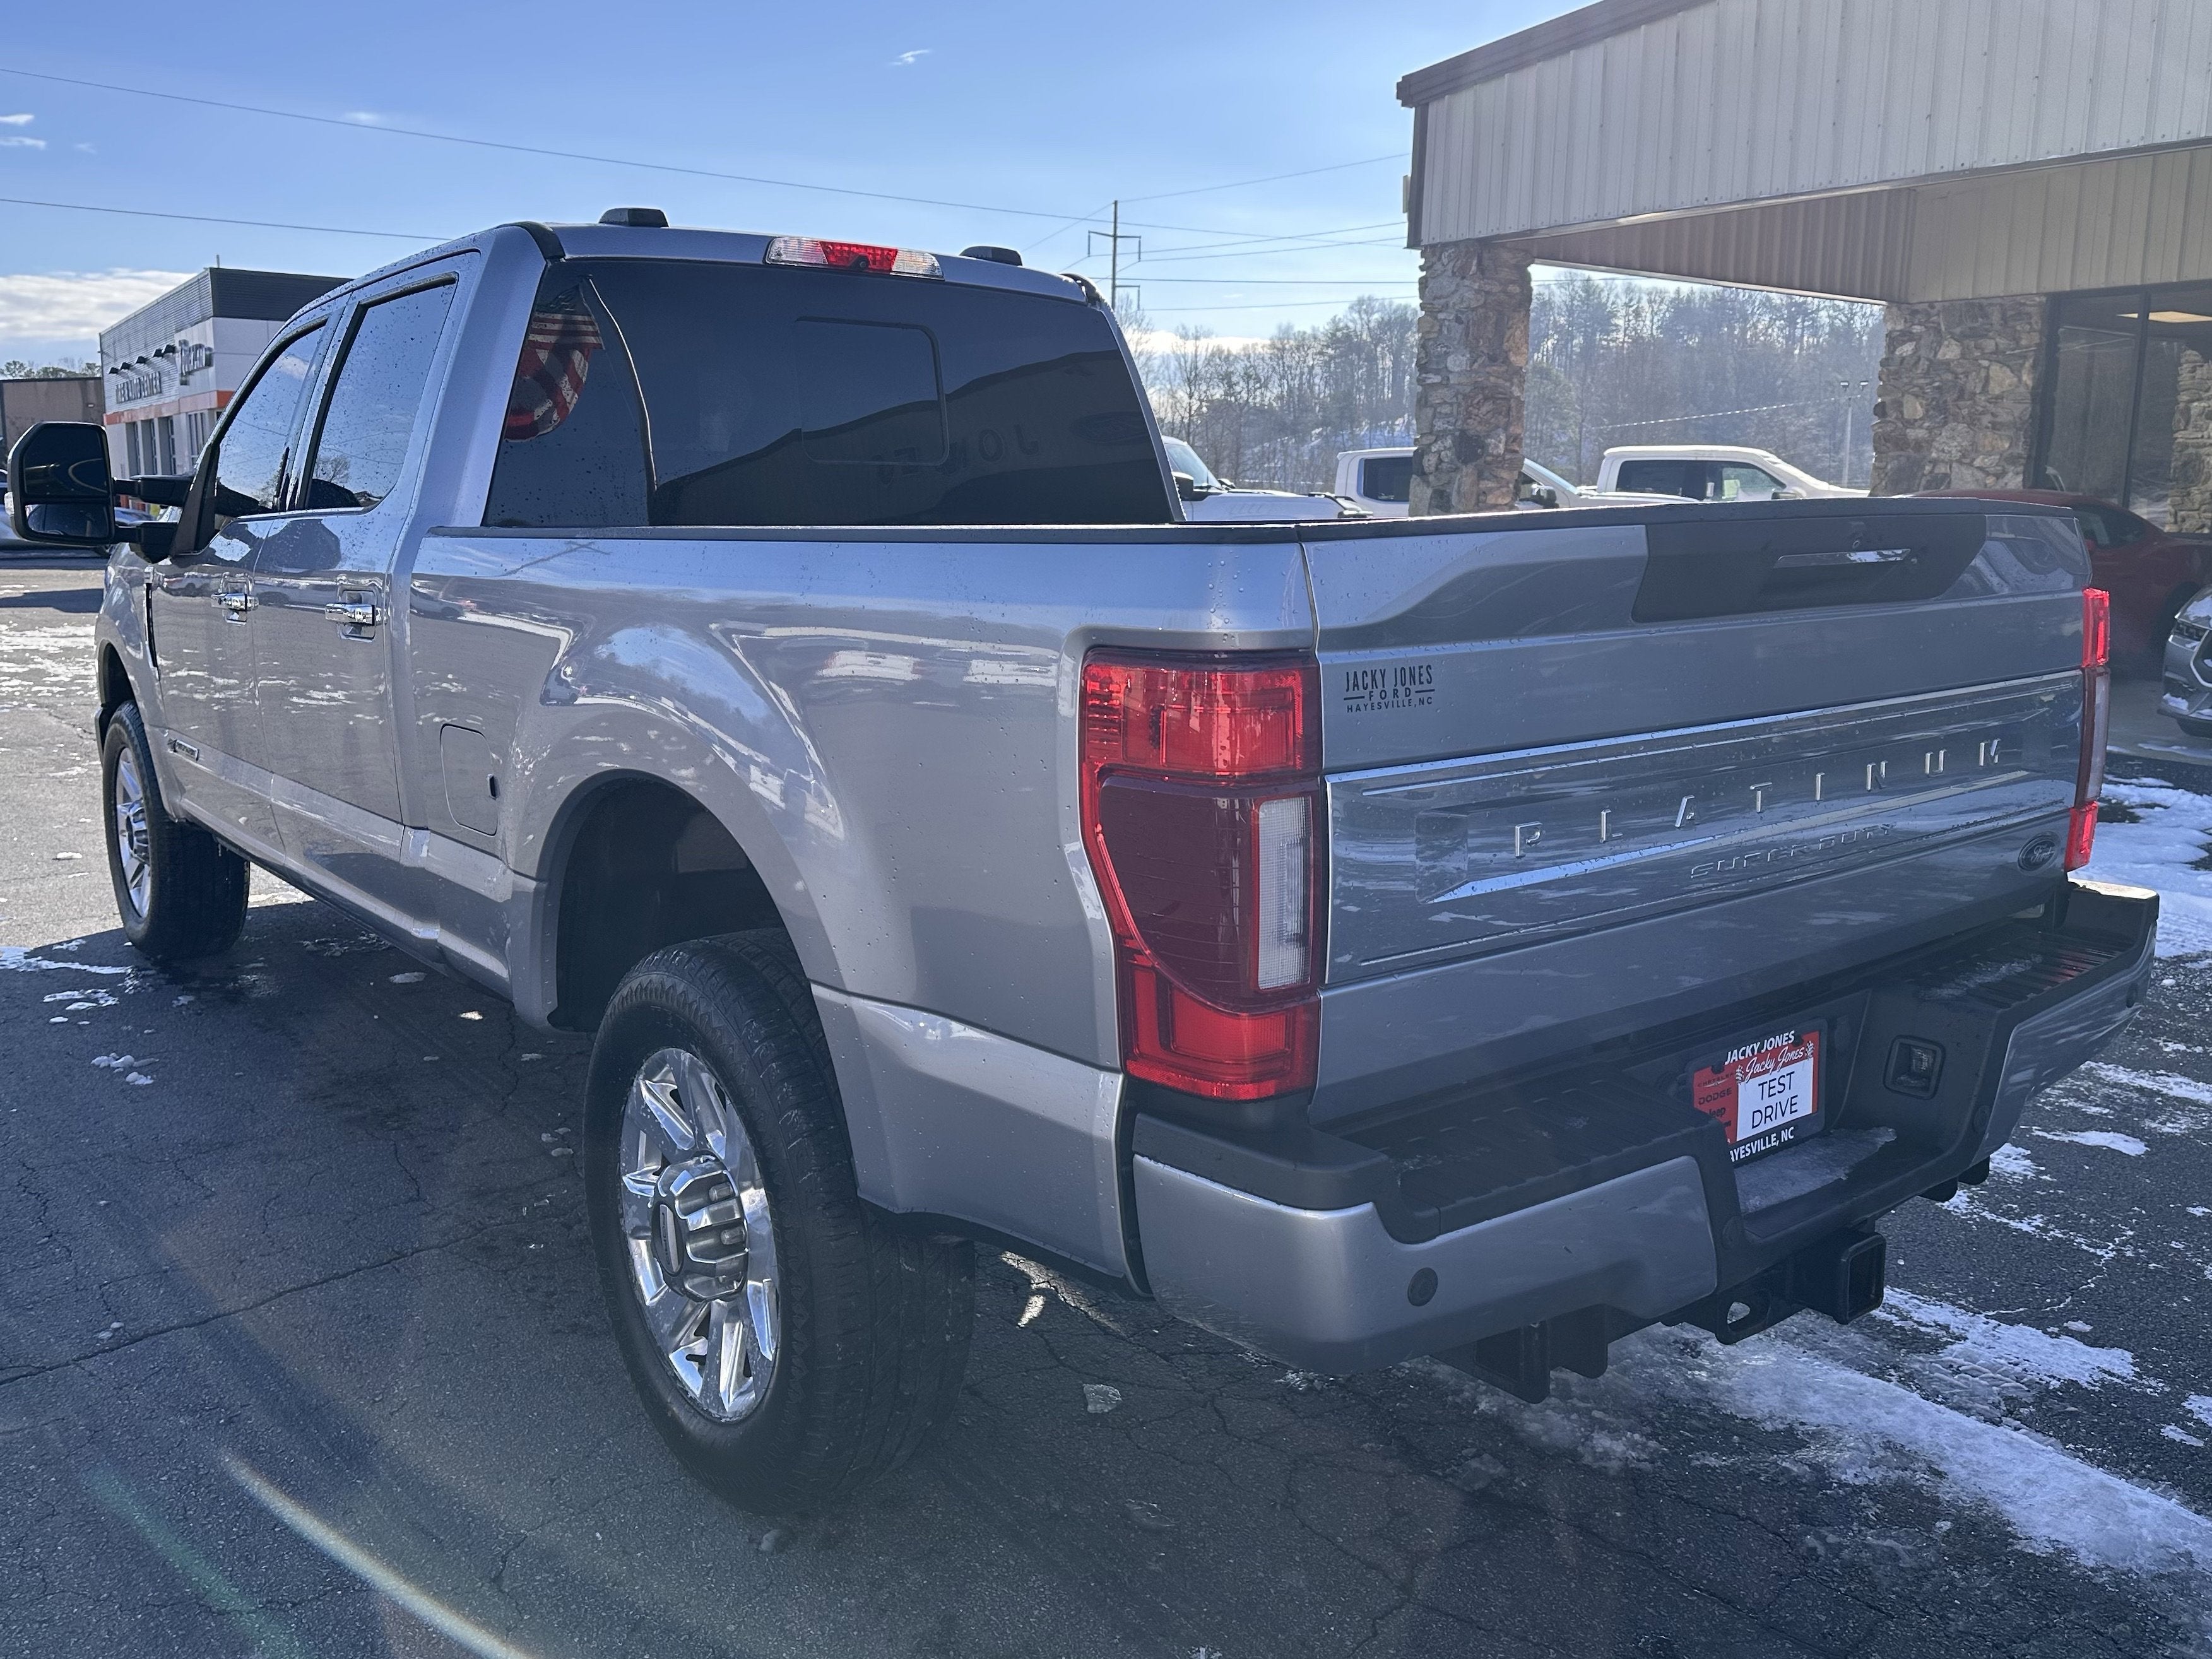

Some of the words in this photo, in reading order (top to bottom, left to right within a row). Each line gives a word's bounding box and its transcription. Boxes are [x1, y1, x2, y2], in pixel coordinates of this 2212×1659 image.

[1346, 668, 1386, 692] JACKY
[1393, 664, 1433, 687] JONES
[1368, 687, 1411, 701] FORD
[1515, 738, 2001, 858] PLATINUM
[1725, 1041, 1761, 1065] JACKY
[1761, 1030, 1795, 1053] JONES
[1744, 1053, 1776, 1083] Jacky
[1777, 1046, 1805, 1071] Jones
[1698, 1087, 1732, 1105] DODGE
[1758, 1071, 1795, 1101] TEST
[1751, 1094, 1798, 1129] DRIVE
[1729, 1133, 1780, 1162] AYESVILLE,
[1781, 1126, 1794, 1143] NC
